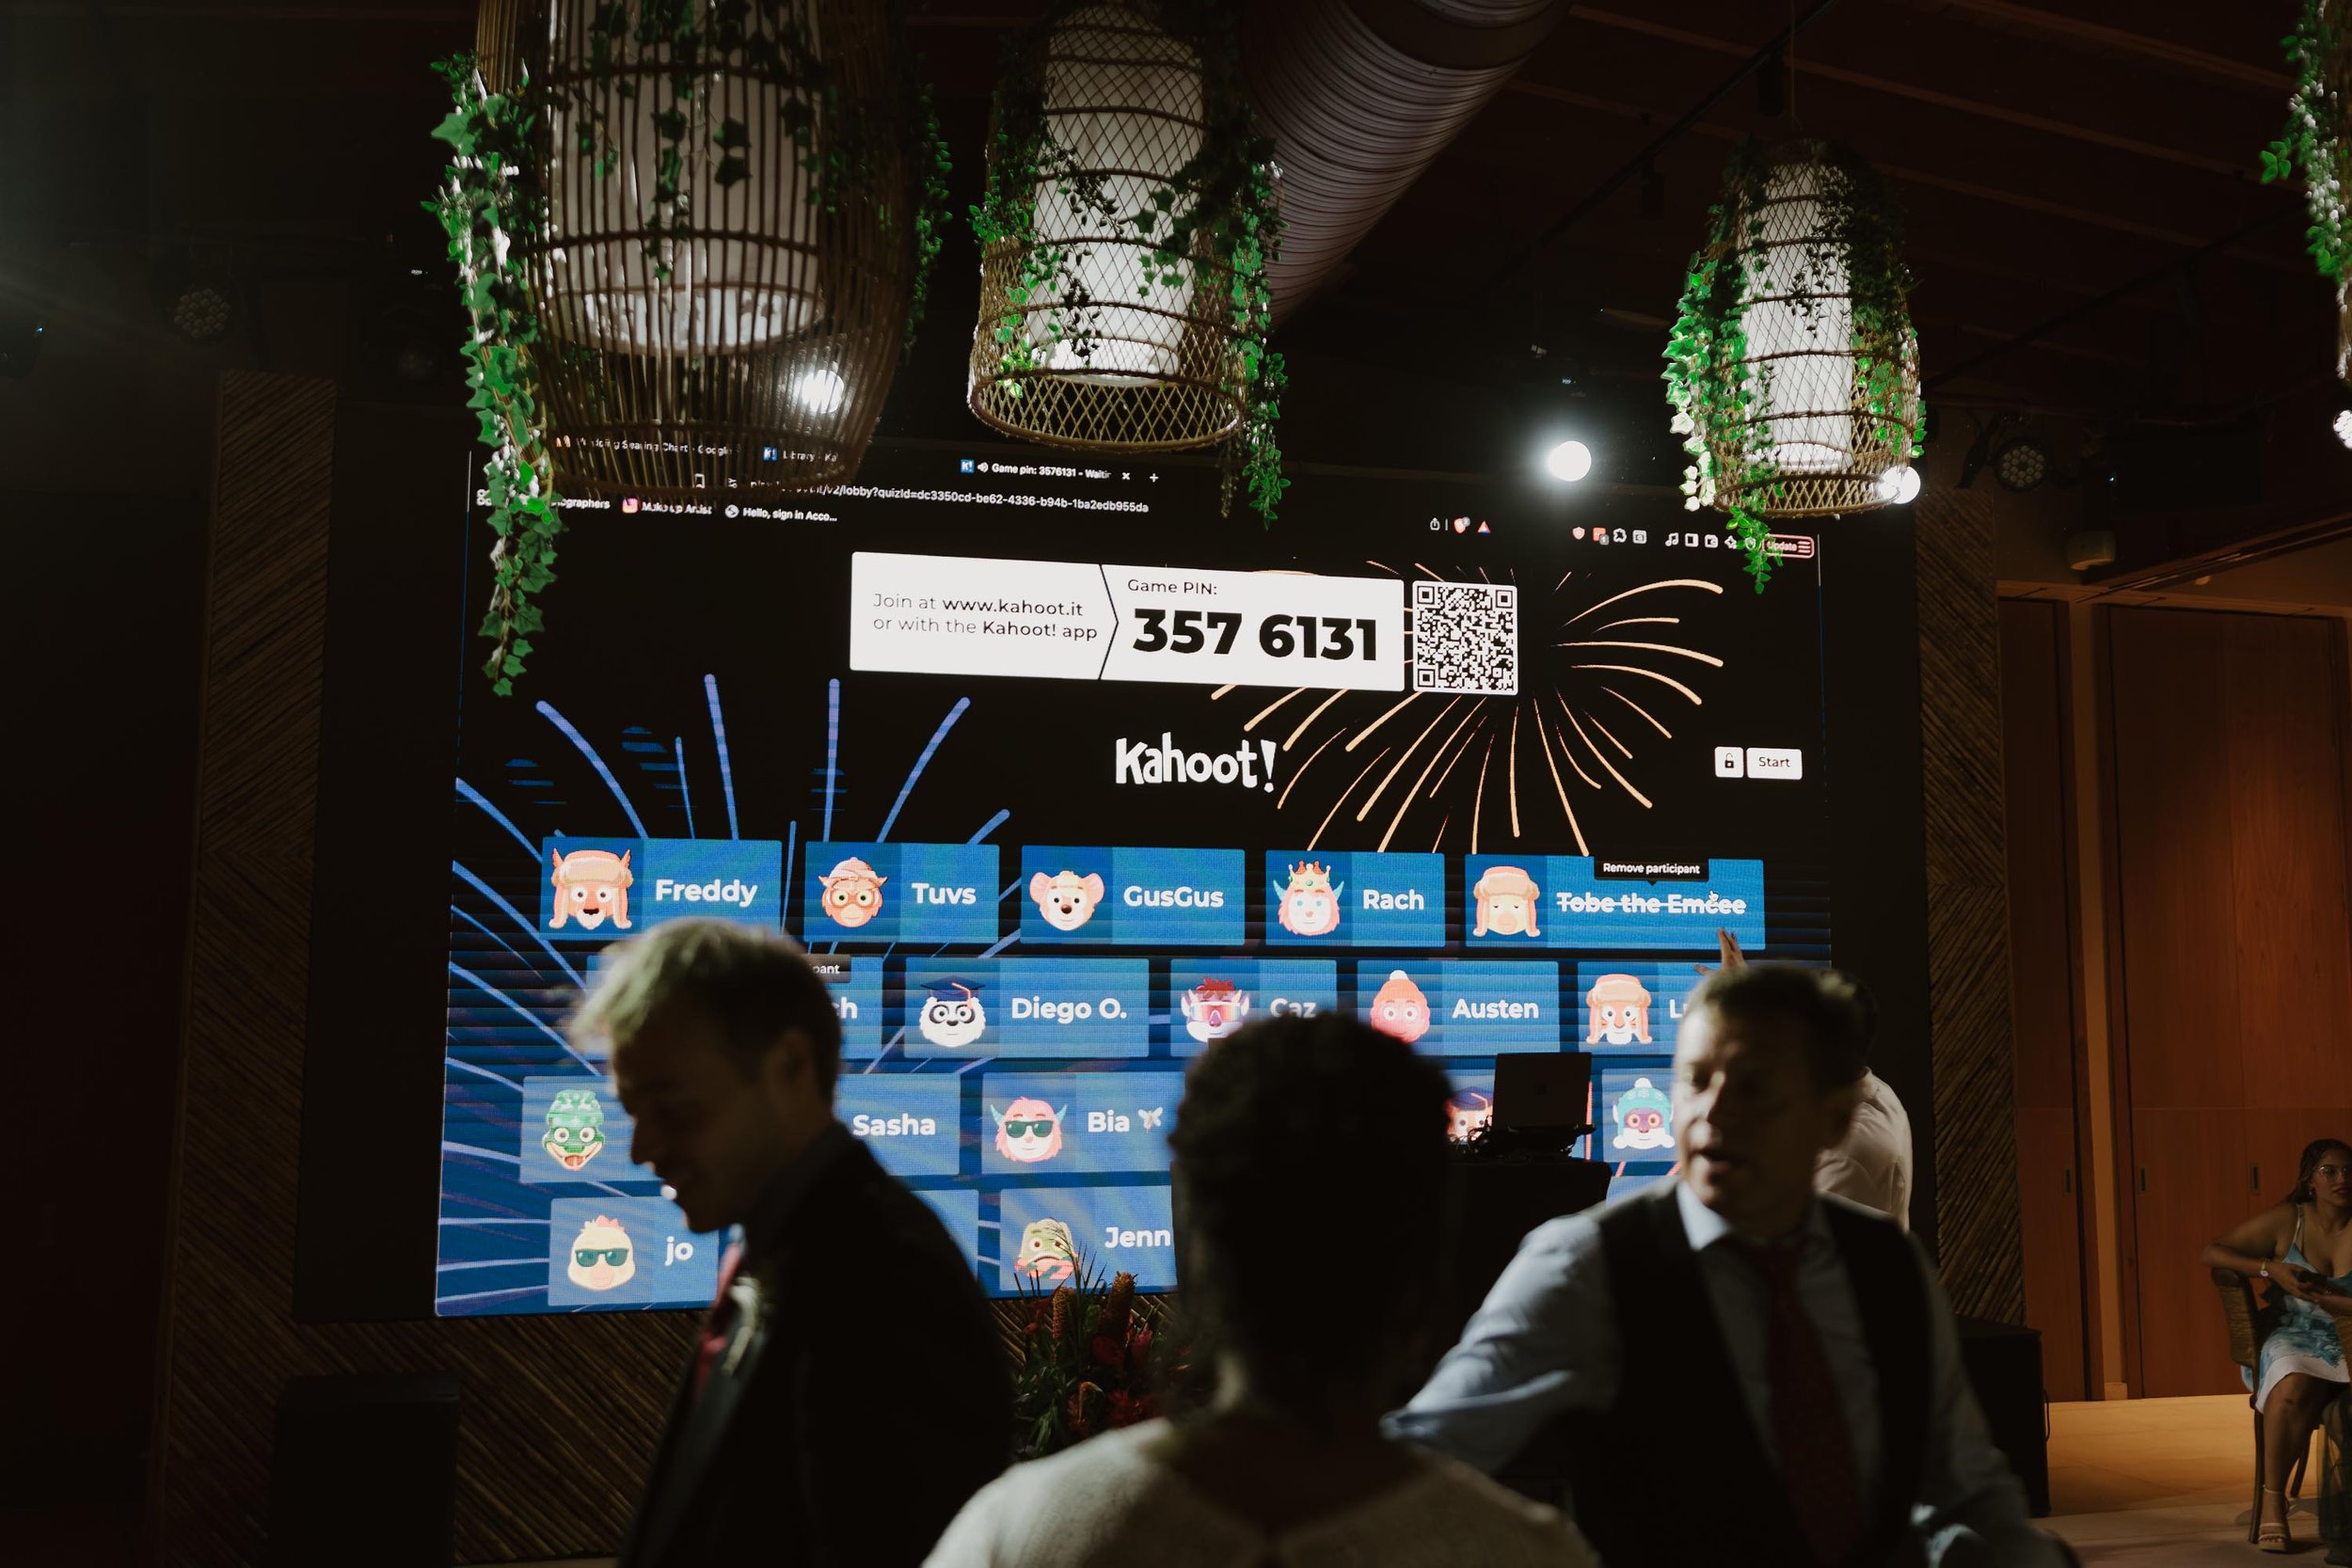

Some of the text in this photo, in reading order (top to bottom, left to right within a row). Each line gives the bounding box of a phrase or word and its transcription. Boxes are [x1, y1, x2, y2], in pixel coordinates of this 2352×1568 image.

[991, 463, 1019, 474] Game
[1019, 465, 1038, 476] pin:
[1038, 466, 1076, 478] 3576131
[742, 507, 771, 519] Hello,
[772, 508, 794, 521] sign
[794, 510, 804, 520] in
[1127, 578, 1217, 595] Game PIN:
[873, 593, 1082, 616] Join at www.kahoot.it
[873, 616, 1098, 641] or with the Kahoot! app
[1133, 608, 1376, 661] 357 6131
[1116, 732, 1277, 793] Kahoot!
[1758, 756, 1789, 768] Start
[1603, 863, 1701, 876] Remove participant
[656, 879, 758, 908] Freddy
[911, 882, 977, 905] Tuvs
[1123, 885, 1224, 908] GusGus
[1363, 888, 1424, 911] Rach
[1556, 891, 1747, 914] Tobe the Emcee
[1011, 995, 1127, 1024] Diego O.
[1269, 997, 1316, 1018] Caz
[1452, 998, 1539, 1019] Austen
[852, 1113, 936, 1136] Sasha
[1088, 1109, 1130, 1132] Bia
[664, 1236, 693, 1266] jo
